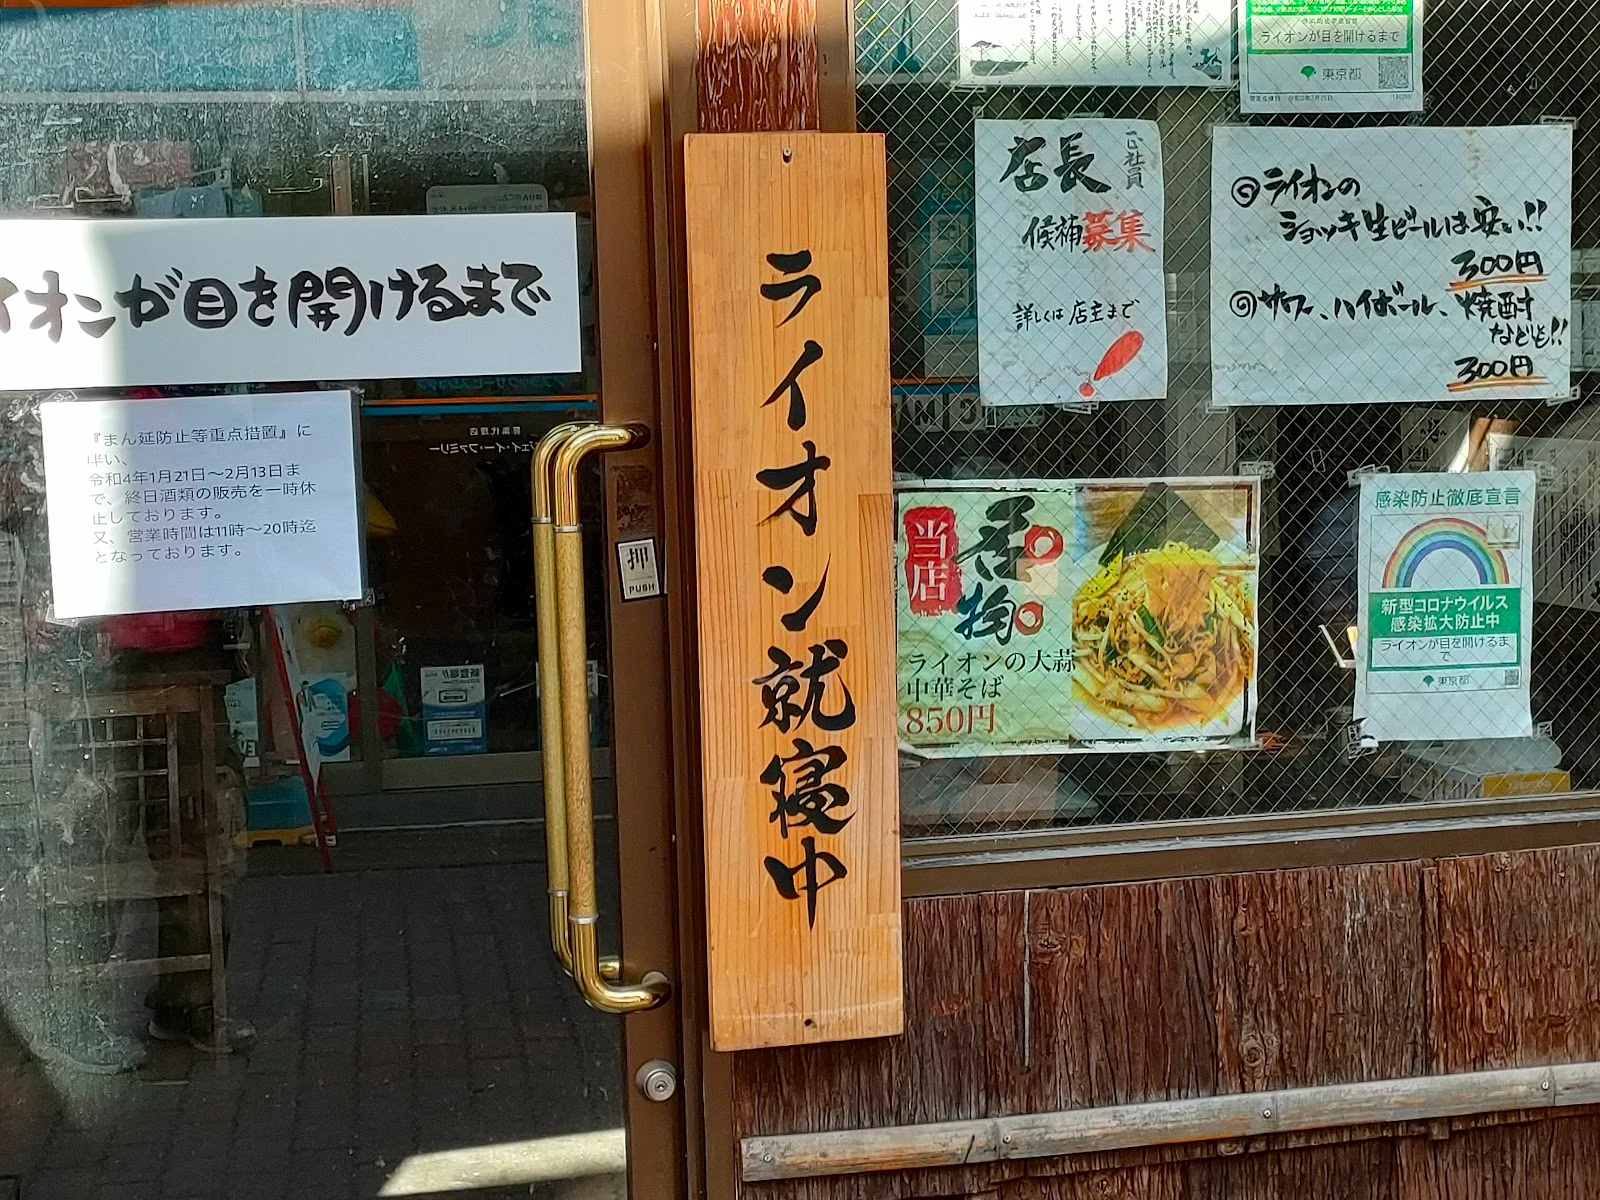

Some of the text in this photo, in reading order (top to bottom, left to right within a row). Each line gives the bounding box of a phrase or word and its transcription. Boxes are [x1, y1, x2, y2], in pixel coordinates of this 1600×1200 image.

[1260, 29, 1399, 44] ライオンが目を開けるまで
[1322, 68, 1361, 81] 東京都
[999, 132, 1112, 193] 店長
[1263, 163, 1361, 206] ライオンの
[1022, 209, 1156, 254] 候補募集
[1450, 249, 1544, 282] 300円
[1454, 354, 1534, 384] 300円
[90, 480, 317, 506] で、終日酒類の販売を一時休
[1375, 487, 1521, 509] 感染防止徹底宣言
[92, 505, 223, 527] 止しております。
[95, 543, 243, 564] となっております。
[911, 519, 949, 602] 当店
[629, 583, 655, 595] PUSH
[752, 248, 857, 930] ライオン就寝中
[1381, 595, 1509, 616] 新型コロナウイルス
[1390, 612, 1500, 633] 感染拡大防止中
[908, 648, 1077, 678] ライオンの大蒜
[907, 675, 1005, 703] 中華そば
[1438, 675, 1470, 686] 東京都
[906, 703, 996, 736] 850円
